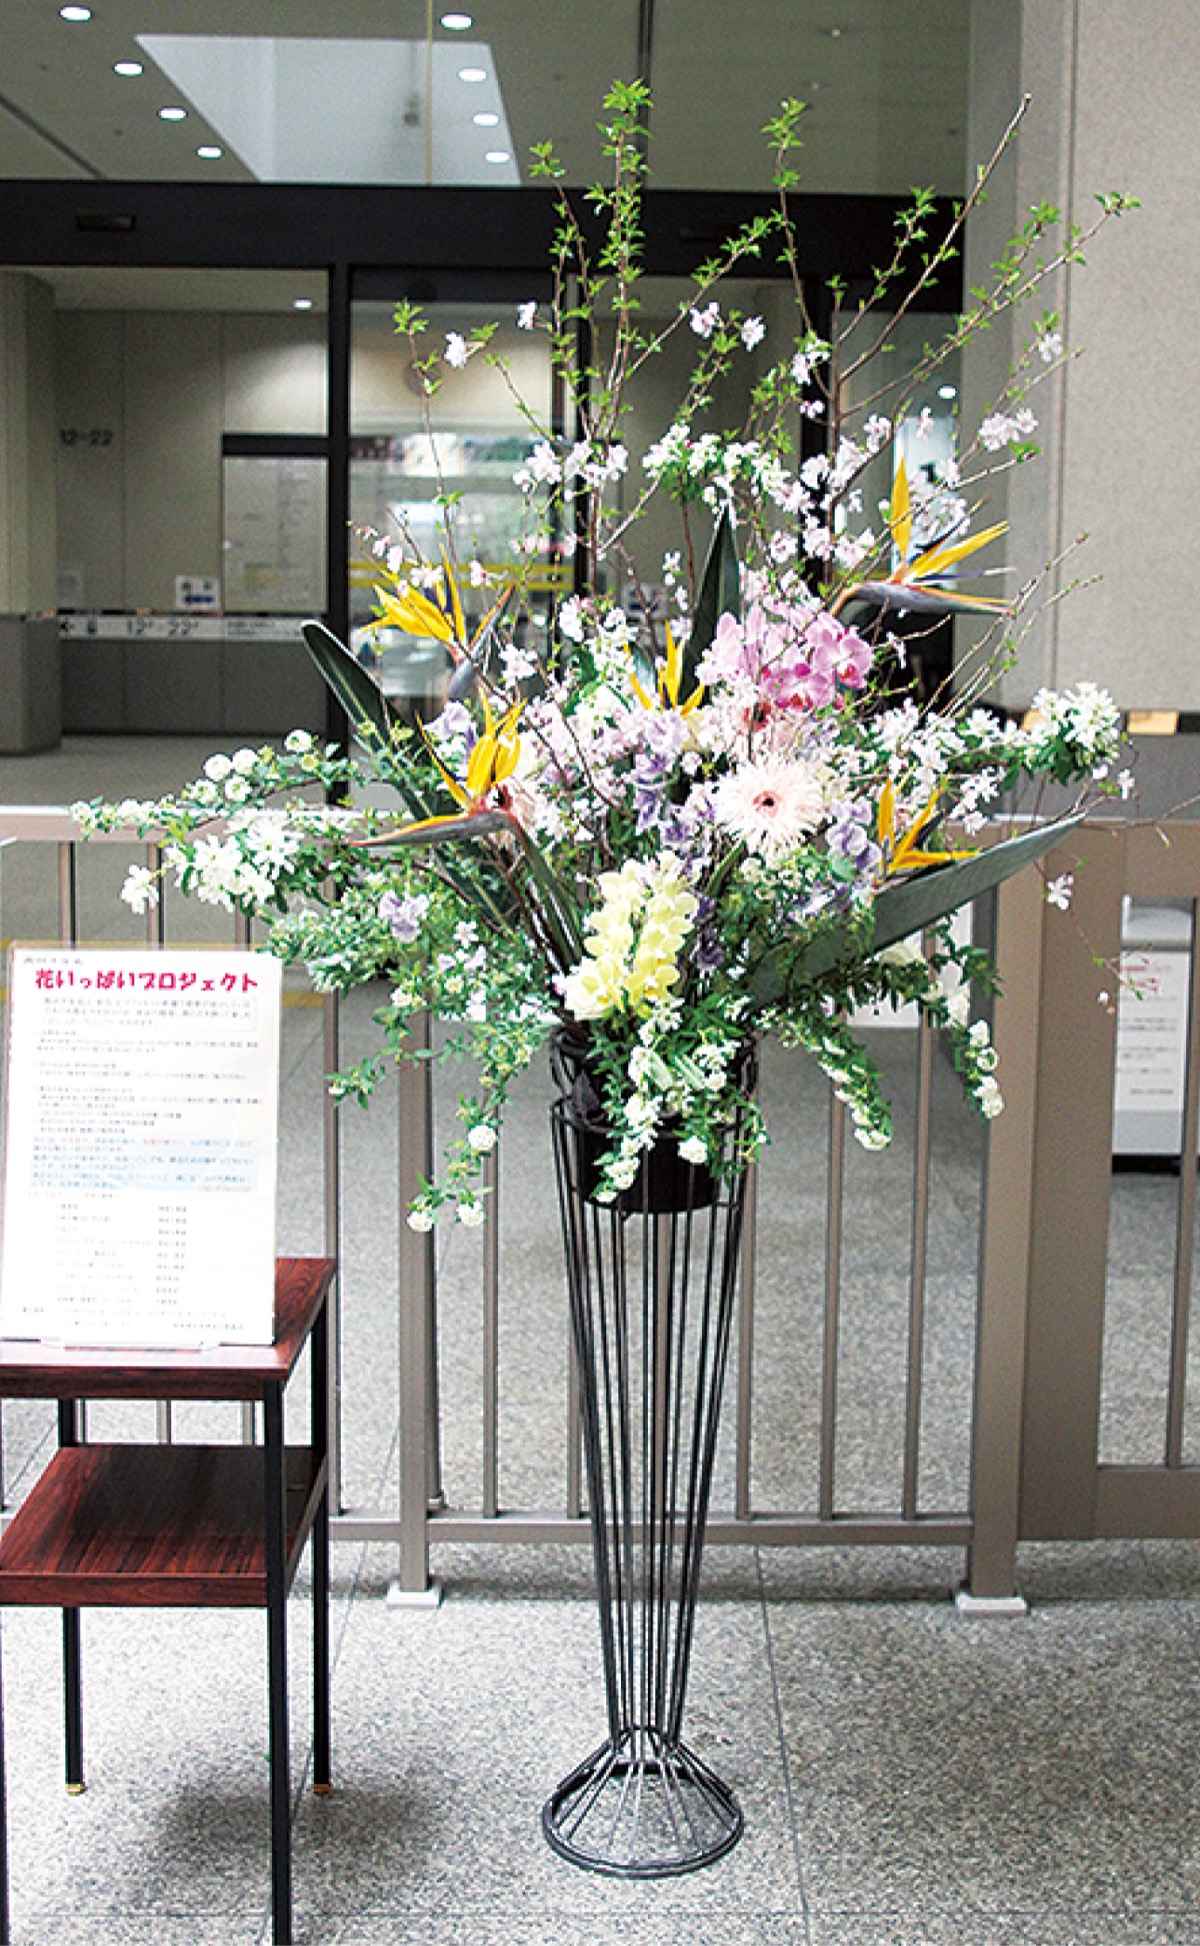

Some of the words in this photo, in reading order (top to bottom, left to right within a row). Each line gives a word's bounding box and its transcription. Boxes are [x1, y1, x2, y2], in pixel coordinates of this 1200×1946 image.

[35, 968, 258, 992] 花いっぱいプロジェクト
